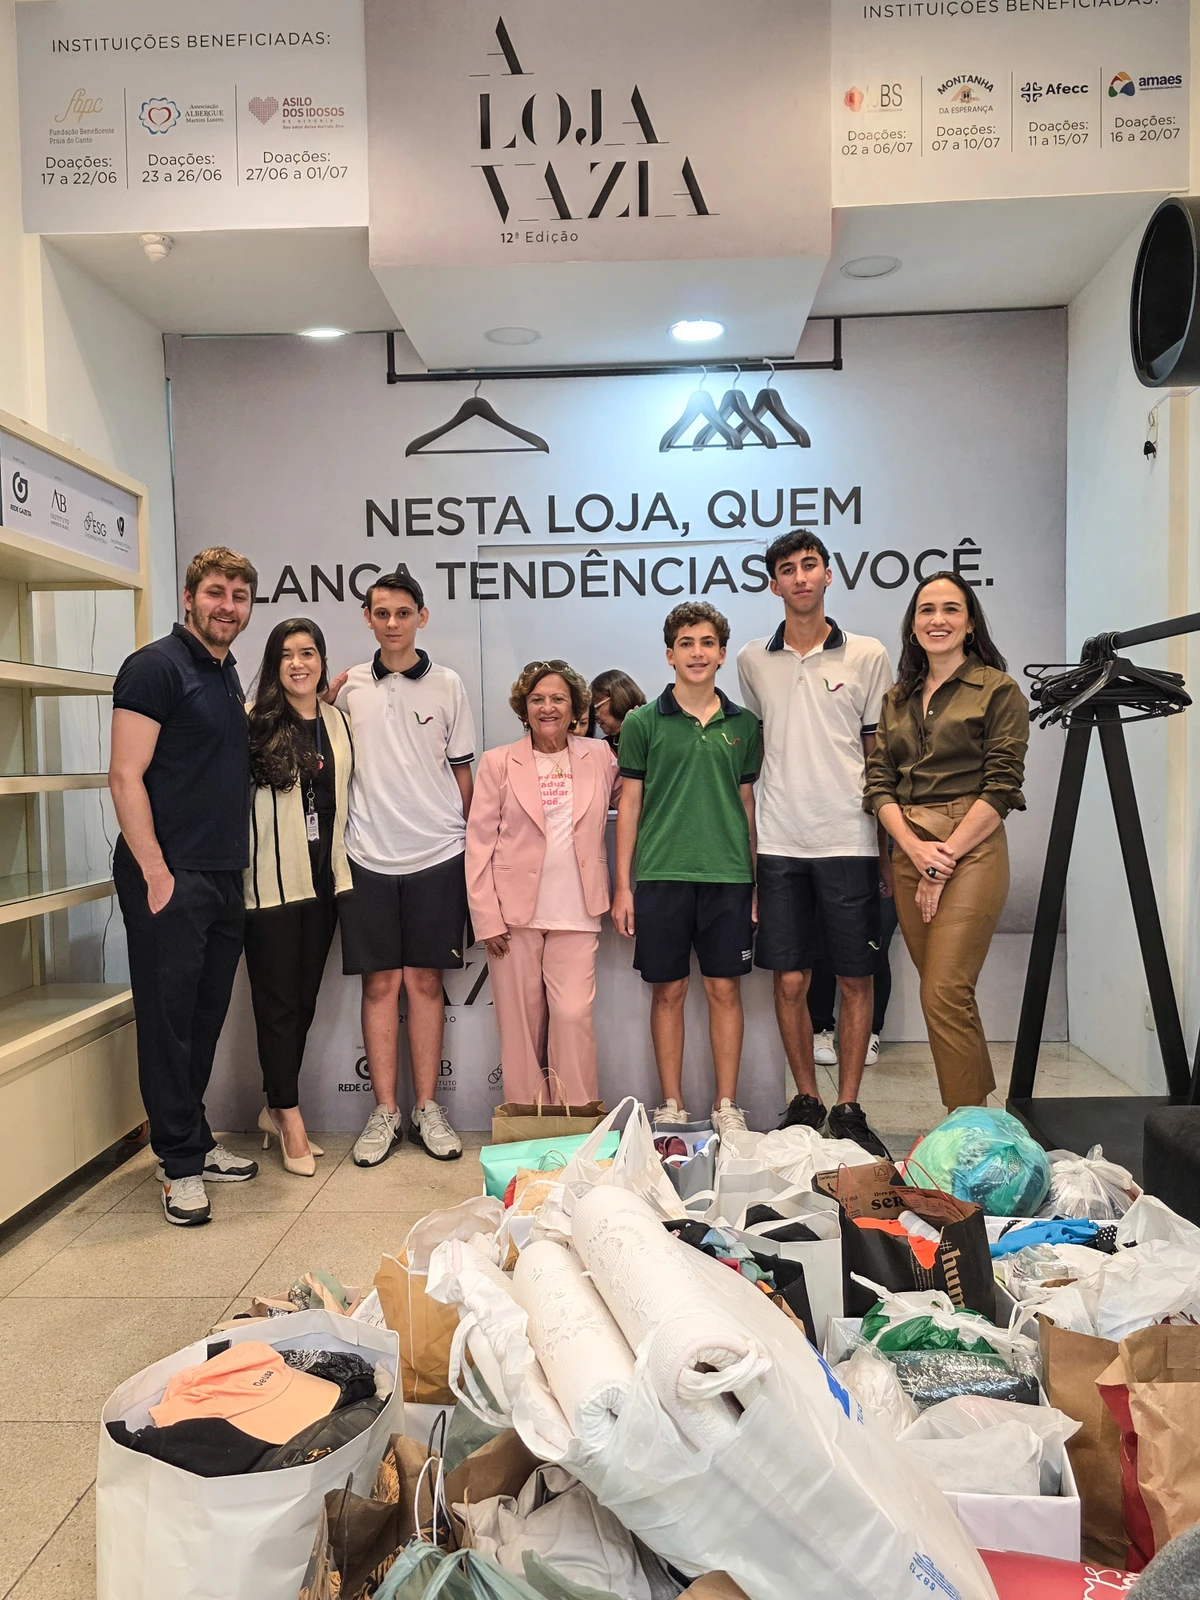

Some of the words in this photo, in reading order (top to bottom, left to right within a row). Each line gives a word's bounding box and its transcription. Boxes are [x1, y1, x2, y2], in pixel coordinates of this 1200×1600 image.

[52, 34, 181, 53] INSTITUIÇÕES
[187, 31, 332, 49] BENEFICIADAS:
[469, 15, 535, 78] A
[937, 74, 995, 95] MONTANHA
[1138, 74, 1183, 87] amaes
[1045, 83, 1089, 95] Afecc
[282, 96, 313, 107] ASILO
[184, 109, 225, 118] ALBERGUE
[282, 107, 304, 118] DOS
[306, 106, 345, 117] IDOSOS
[479, 84, 670, 150] LOJA
[938, 107, 950, 115] DA
[951, 105, 994, 115] ESPERANÇA
[1028, 119, 1089, 133] Doações:
[1114, 114, 1176, 129] Doações:
[48, 128, 79, 137] Fundação
[79, 127, 116, 136] Beneficente
[847, 129, 907, 142] Doações:
[936, 124, 996, 138] Doações:
[1110, 131, 1124, 143] 16
[1127, 133, 1136, 142] a
[1139, 127, 1181, 142] 20/07
[48, 137, 66, 145] Praia
[66, 136, 75, 144] do
[75, 136, 93, 144] Canto
[931, 139, 949, 152] 07
[952, 141, 960, 150] a
[963, 136, 1001, 151] 10/07
[1027, 135, 1038, 147] 11
[1041, 137, 1049, 146] a
[1052, 133, 1089, 147] 15/07
[841, 144, 858, 156] 02
[861, 146, 869, 155] a
[873, 141, 914, 155] 06/07
[45, 155, 113, 171] Doações:
[148, 152, 216, 168] Doações:
[262, 150, 332, 165] Doações:
[41, 173, 55, 185] 17
[59, 176, 68, 185] a
[72, 171, 118, 187] 22/06
[141, 169, 160, 183] 23
[164, 172, 172, 182] a
[177, 167, 223, 184] 26/06
[245, 166, 289, 182] 27/06
[293, 169, 302, 180] a
[306, 164, 349, 181] 01/07
[471, 155, 721, 225] VAZIA
[500, 231, 520, 244] 12ª
[525, 230, 579, 244] Edição
[365, 495, 532, 538] NESTA
[547, 491, 691, 538] LOJA,
[706, 485, 863, 530] QUEM
[92, 519, 107, 538] ESG
[254, 561, 414, 609] ANÇ
[435, 548, 770, 601] TENDÊNCIAS
[833, 536, 994, 591] VOCÊ.
[541, 780, 566, 788] aduz
[540, 788, 569, 797] uidar
[542, 797, 562, 806] ocê.
[338, 1083, 361, 1092] REDE
